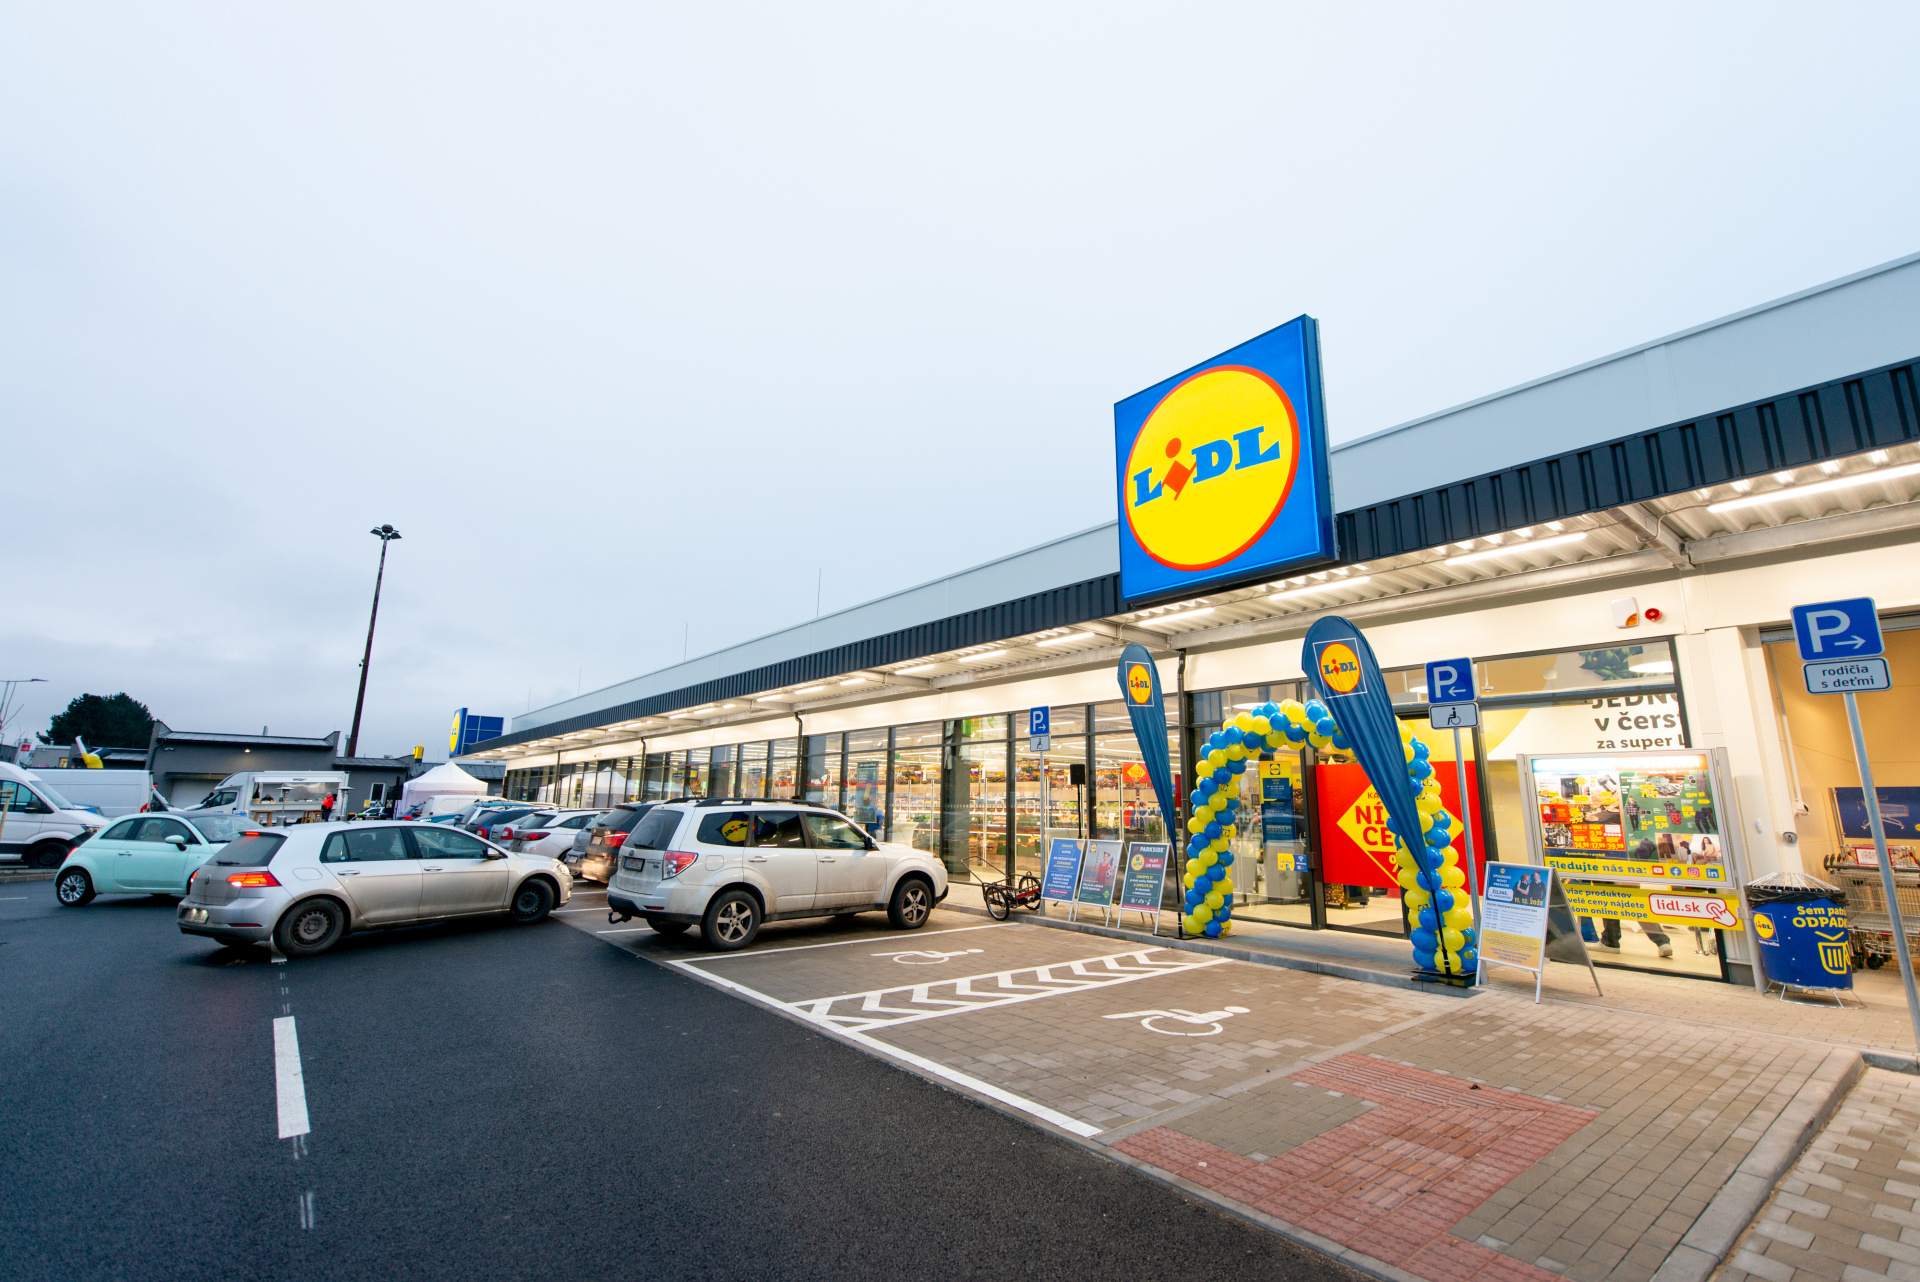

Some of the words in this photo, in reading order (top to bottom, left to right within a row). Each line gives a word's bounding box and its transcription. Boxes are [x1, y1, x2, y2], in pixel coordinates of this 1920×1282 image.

[1133, 426, 1281, 508] LIDL
[1806, 609, 1851, 653] P
[1822, 664, 1869, 677] rodičia
[1433, 665, 1458, 698] P
[1821, 681, 1829, 689] s
[1833, 675, 1875, 688] deťmi
[1032, 710, 1044, 732] P
[1594, 717, 1610, 732] v
[1617, 711, 1681, 731] čers
[1596, 739, 1616, 749] za
[1620, 737, 1672, 750] super
[1549, 860, 1598, 873] Sledujte
[1602, 863, 1624, 873] nás
[1585, 888, 1632, 899] produktov
[1588, 899, 1608, 907] ceny
[1611, 899, 1645, 909] nájdete
[1656, 899, 1700, 913] lidl.sk
[1796, 905, 1825, 915] Sem
[1591, 907, 1618, 916] online
[1620, 909, 1648, 918] shope
